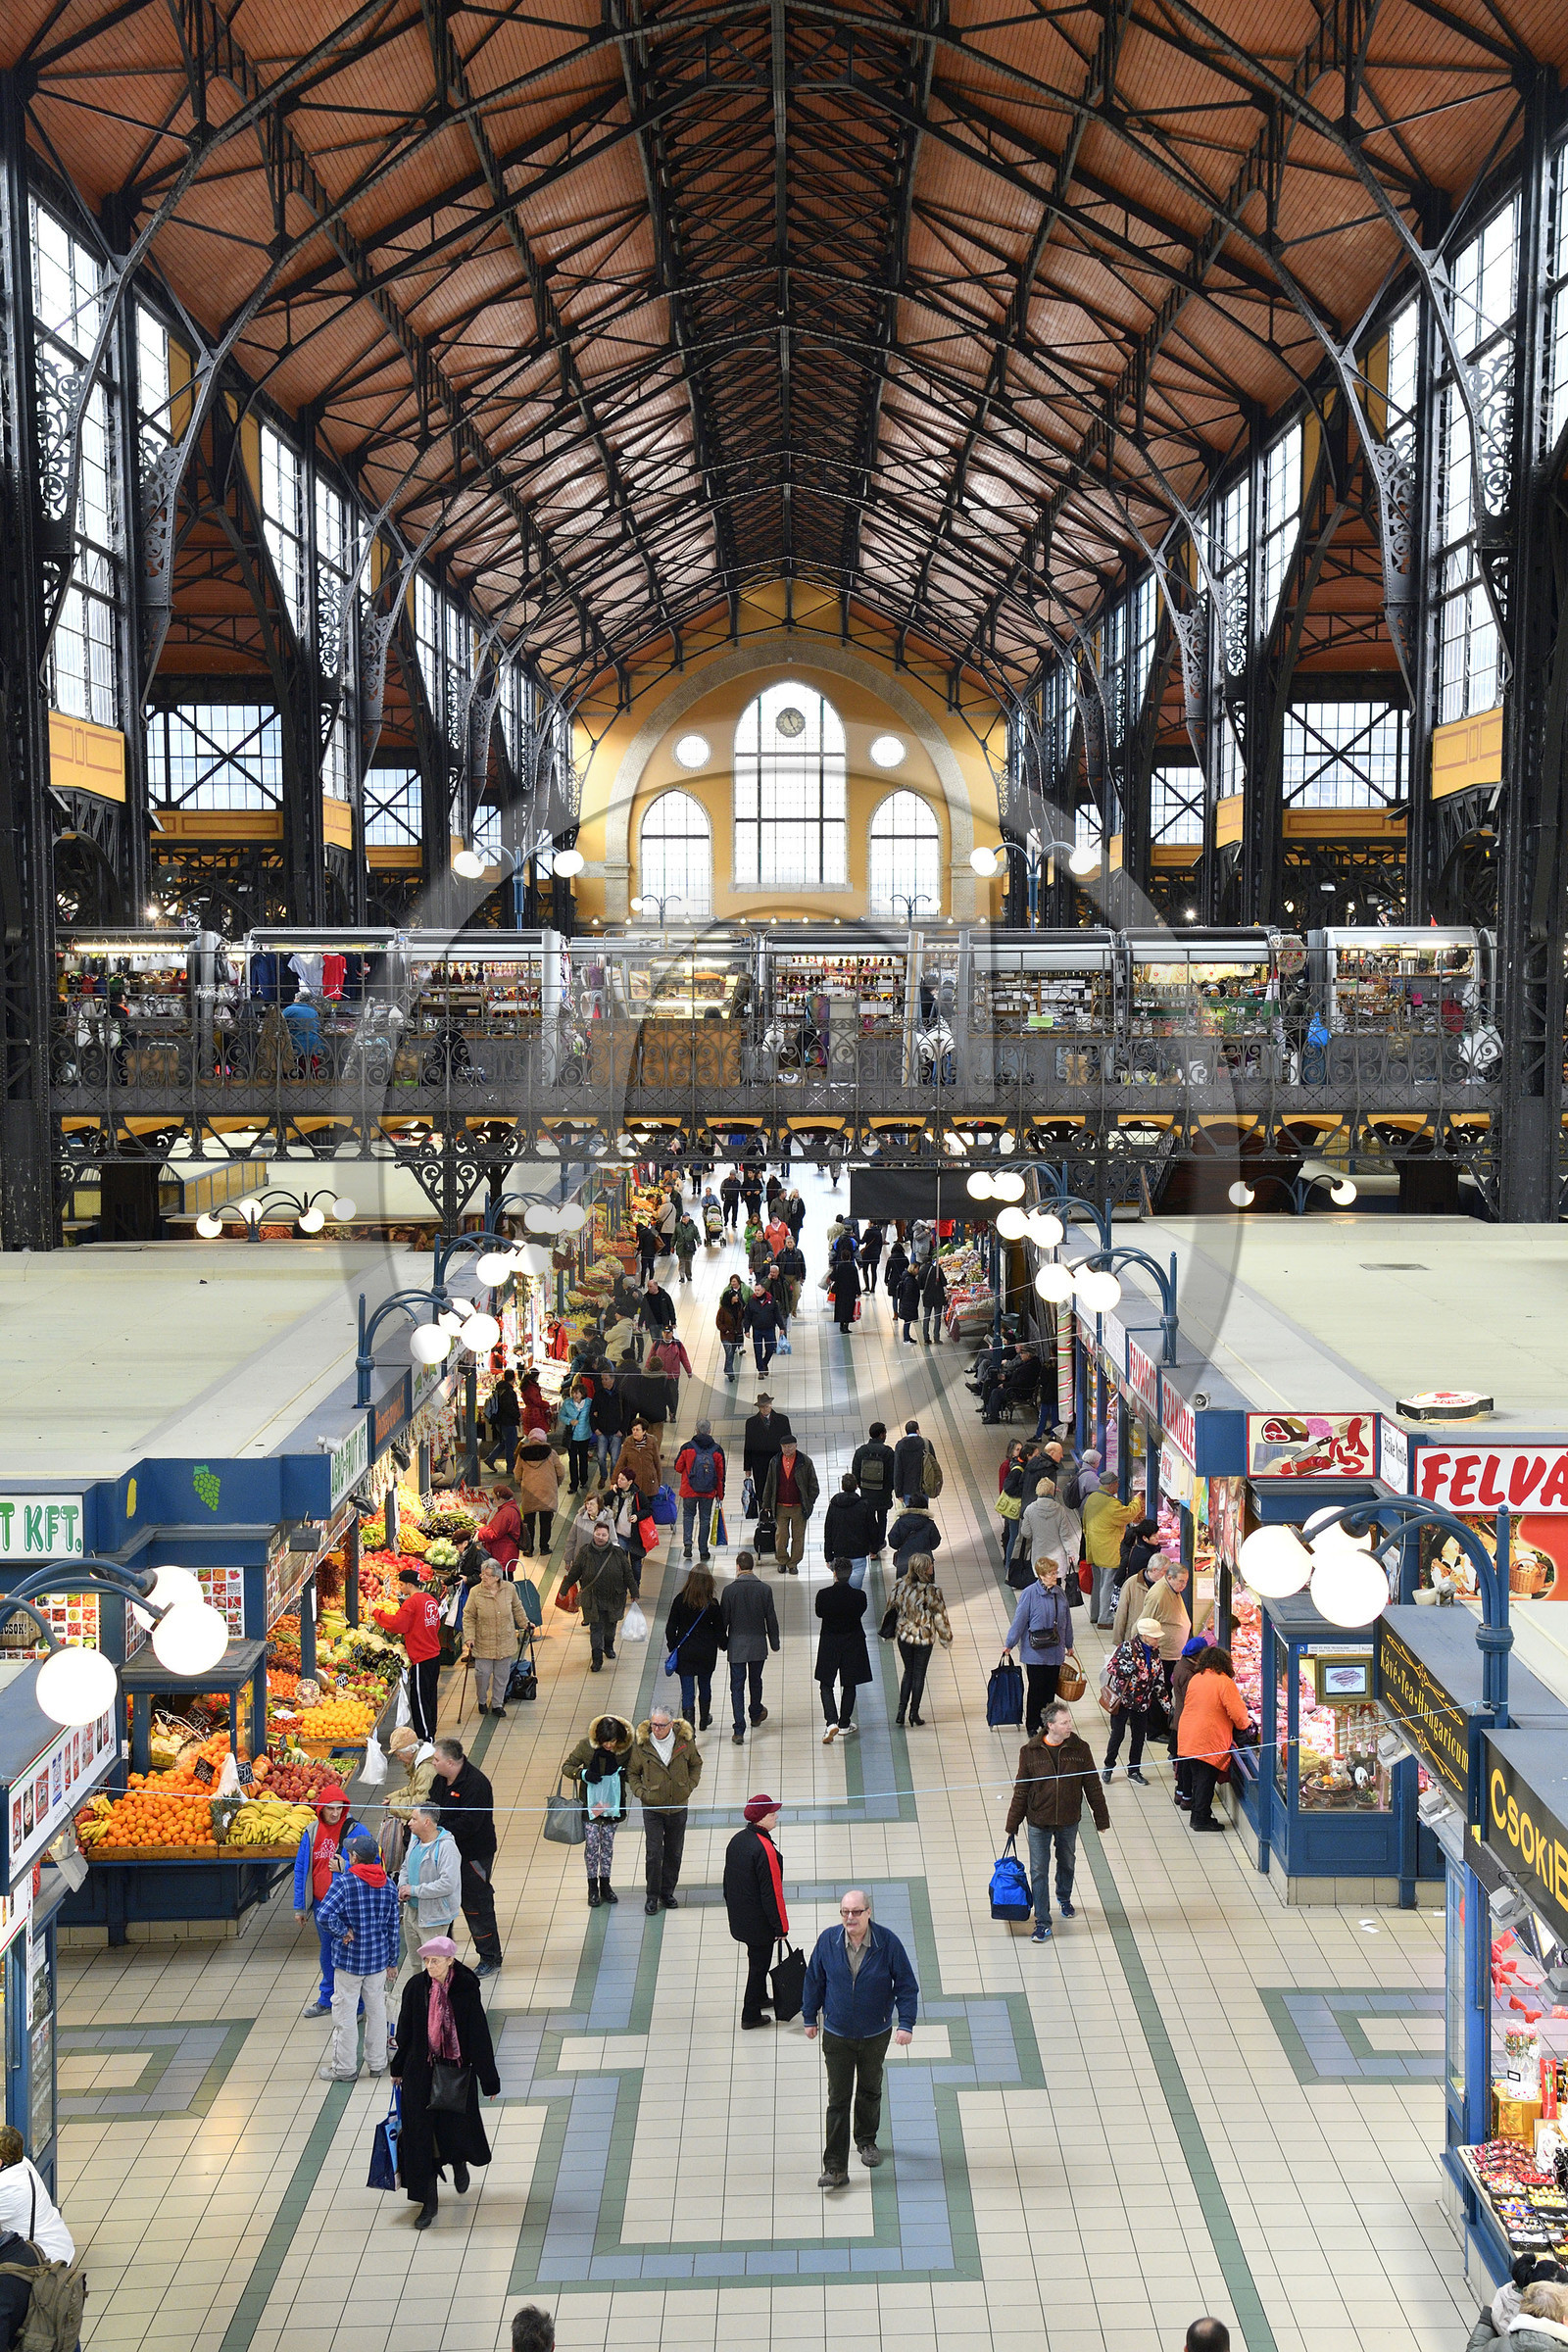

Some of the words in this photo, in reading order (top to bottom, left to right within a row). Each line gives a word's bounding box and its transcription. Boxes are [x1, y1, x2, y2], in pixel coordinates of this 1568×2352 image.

[24, 1504, 82, 1553] KFT.
[1401, 1670, 1414, 1704] Tea
[1417, 1690, 1469, 1774] Hungaricum
